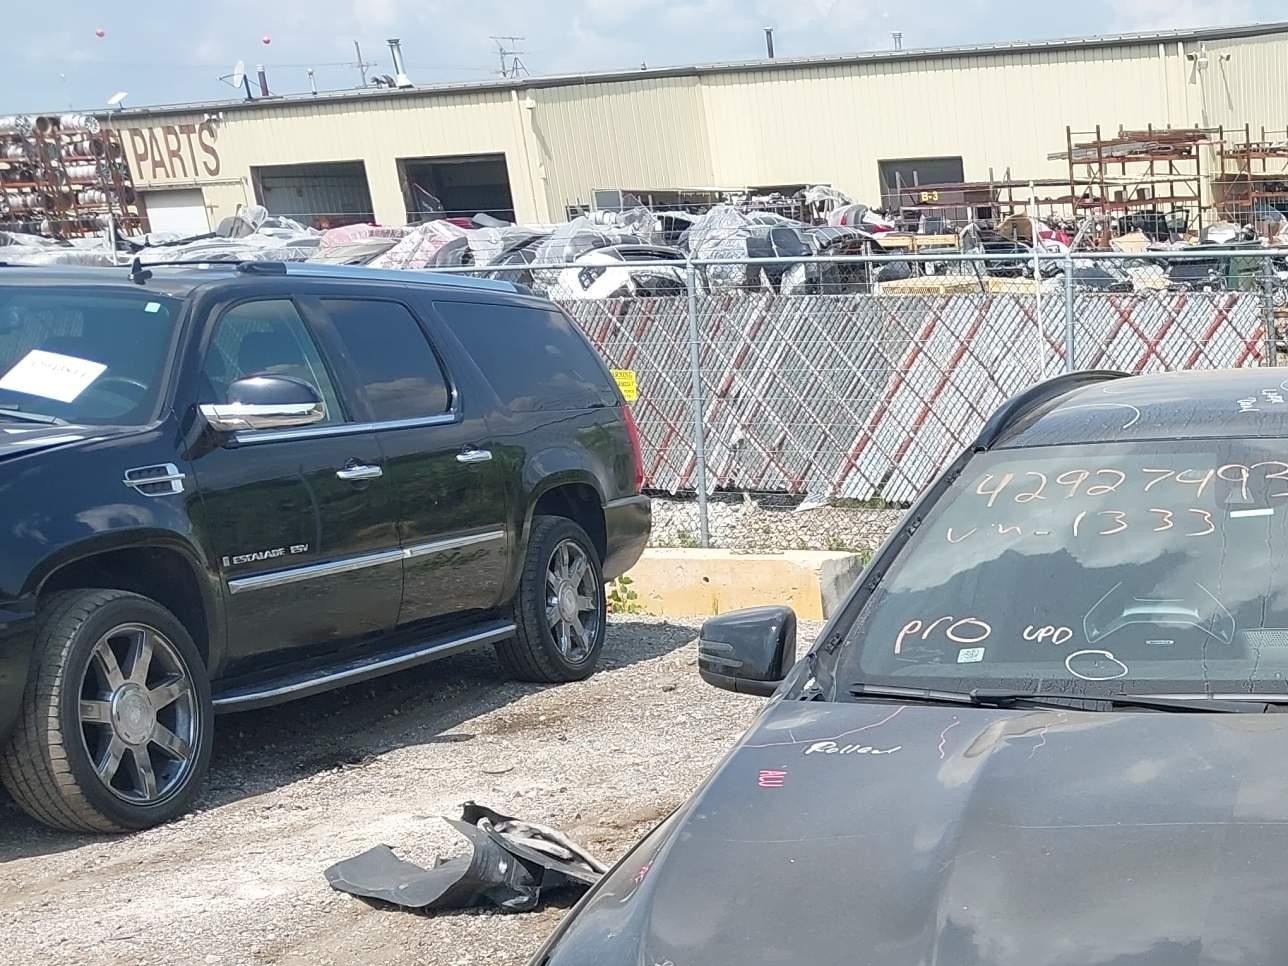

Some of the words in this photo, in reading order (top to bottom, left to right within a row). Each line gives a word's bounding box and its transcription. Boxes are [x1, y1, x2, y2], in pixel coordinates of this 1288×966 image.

[127, 121, 221, 179] PARTS
[921, 190, 939, 201] B-3
[1073, 508, 1215, 537] 1333
[290, 543, 309, 554] ESV
